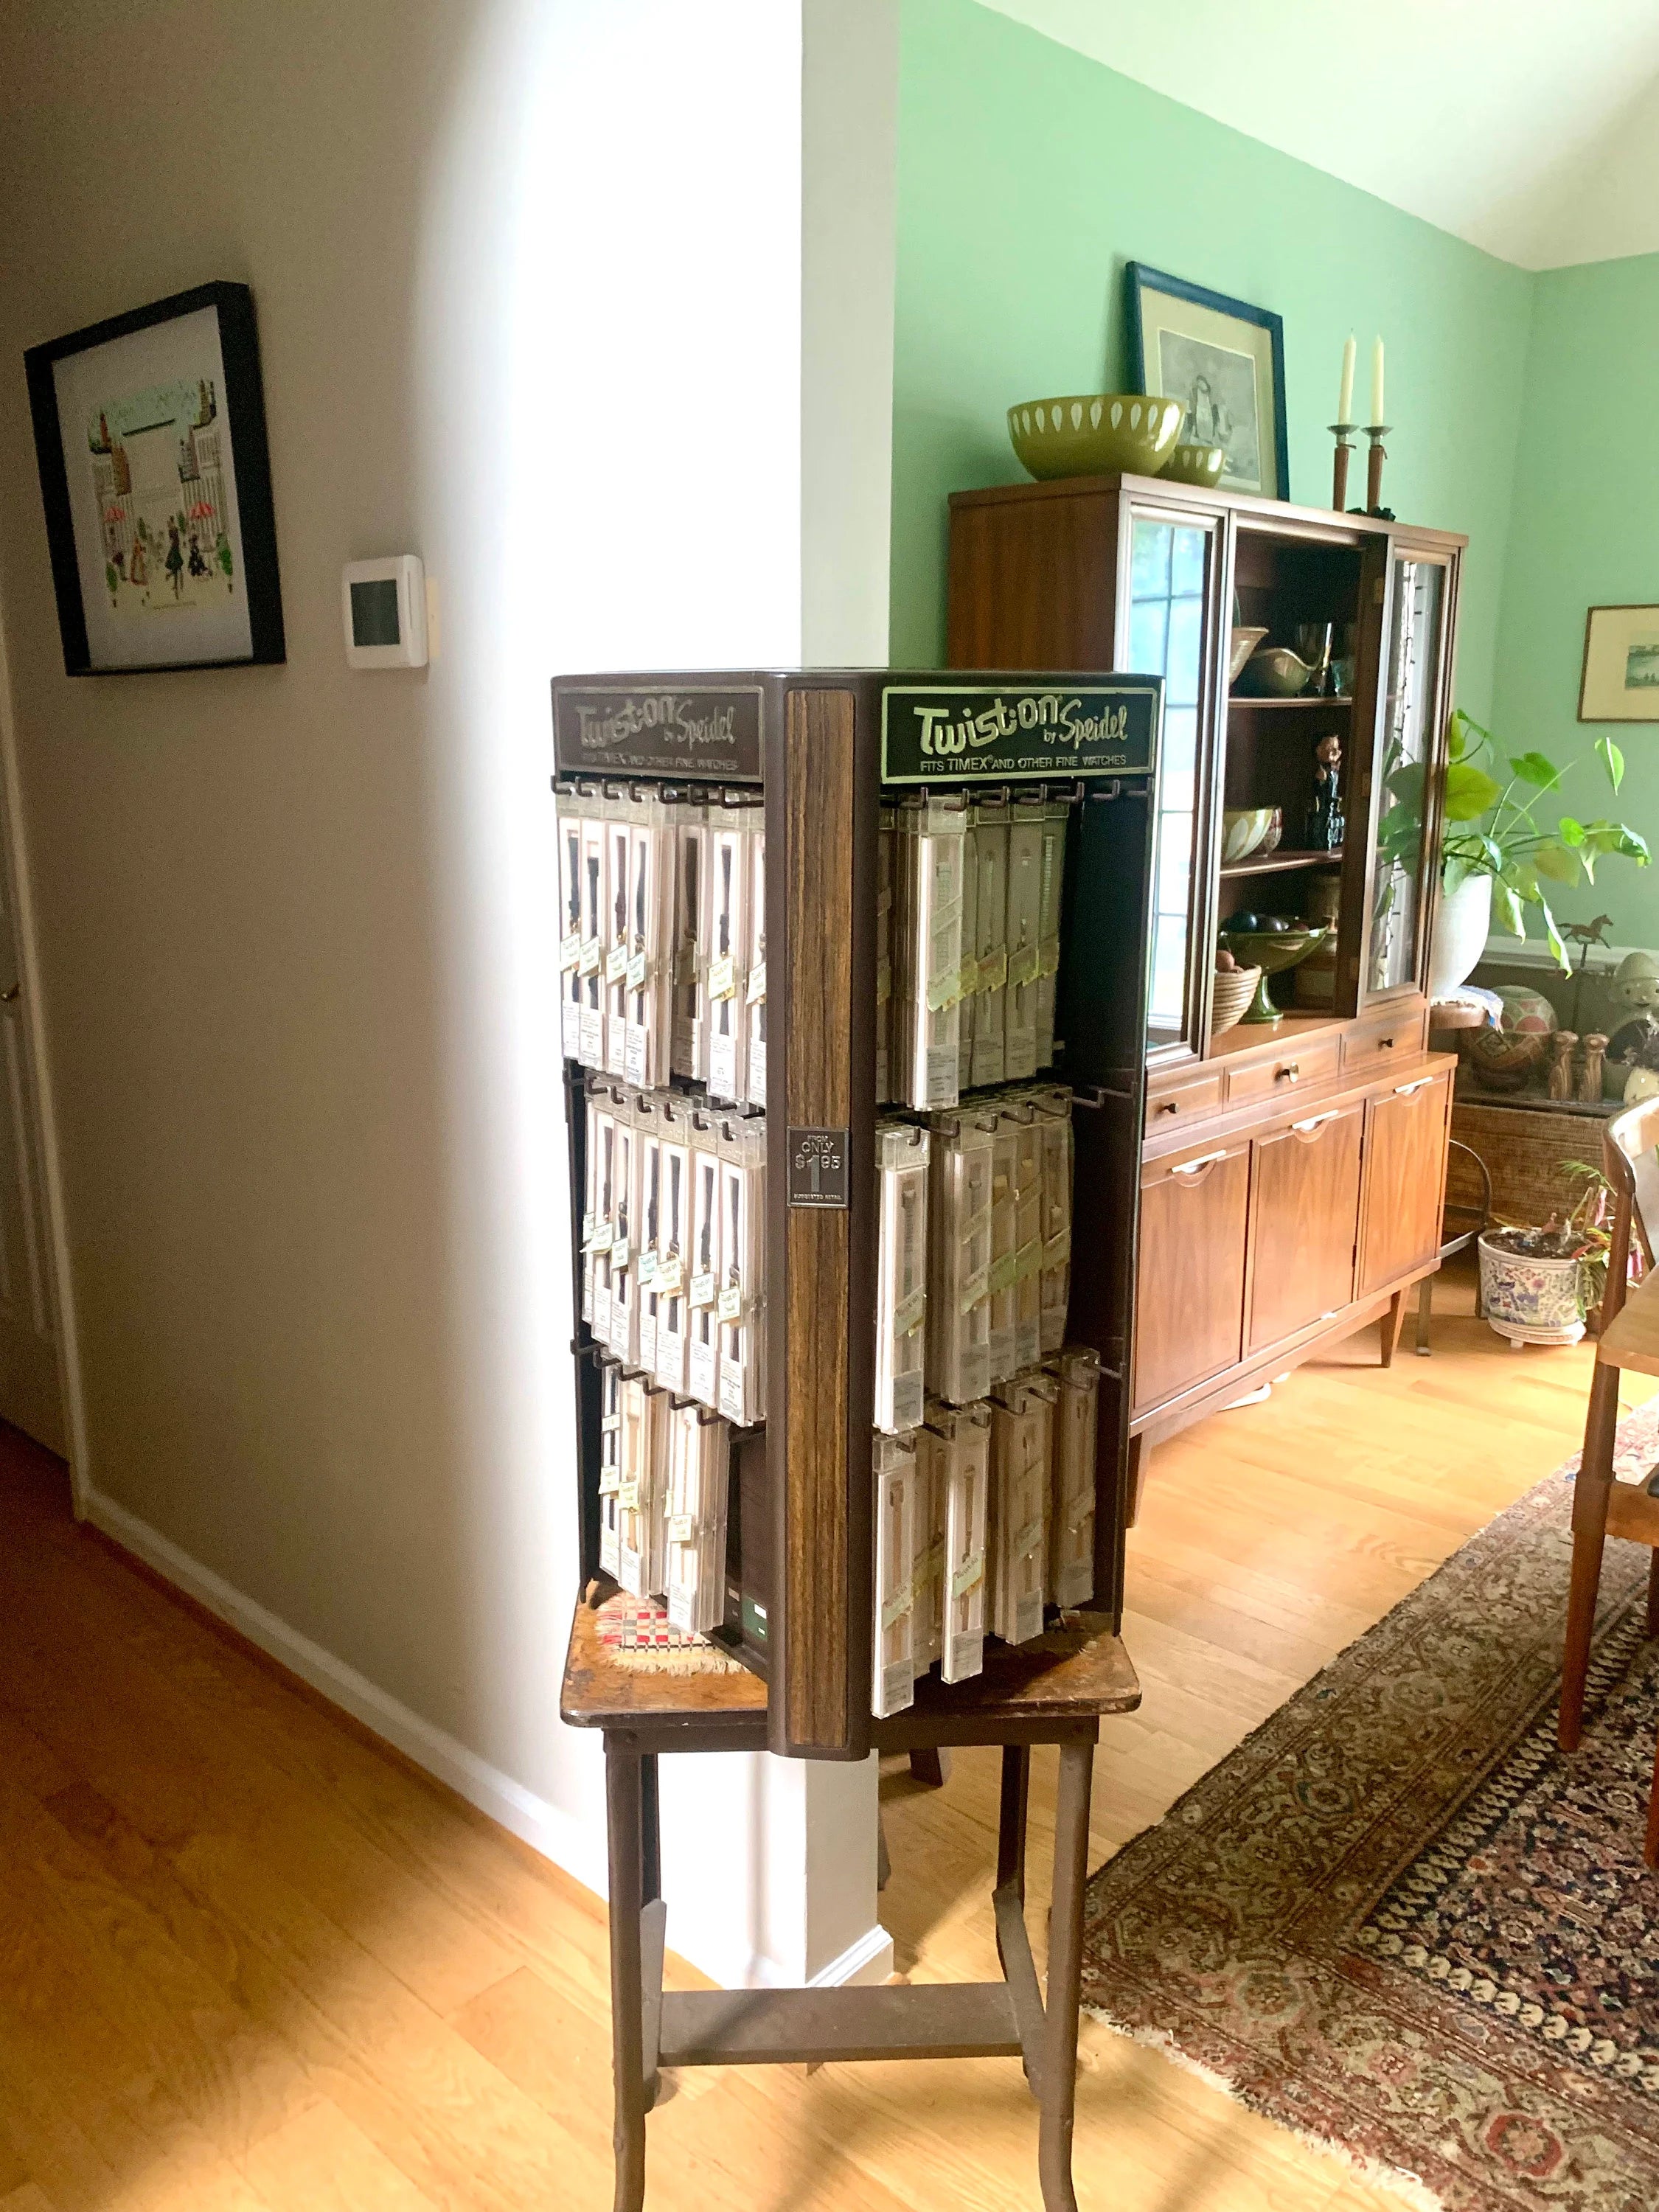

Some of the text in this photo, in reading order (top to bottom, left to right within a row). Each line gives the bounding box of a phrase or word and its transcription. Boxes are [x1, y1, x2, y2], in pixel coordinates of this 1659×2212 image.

[677, 699, 737, 751] Speidel
[1043, 729, 1057, 745] by
[1059, 699, 1128, 751] Speidel
[920, 761, 945, 772] FITS
[991, 758, 1015, 770] AND
[1018, 757, 1052, 769] OTHER
[1056, 757, 1078, 768] FINE
[1082, 754, 1127, 766] WATCHES
[801, 1141, 834, 1153] ONLY
